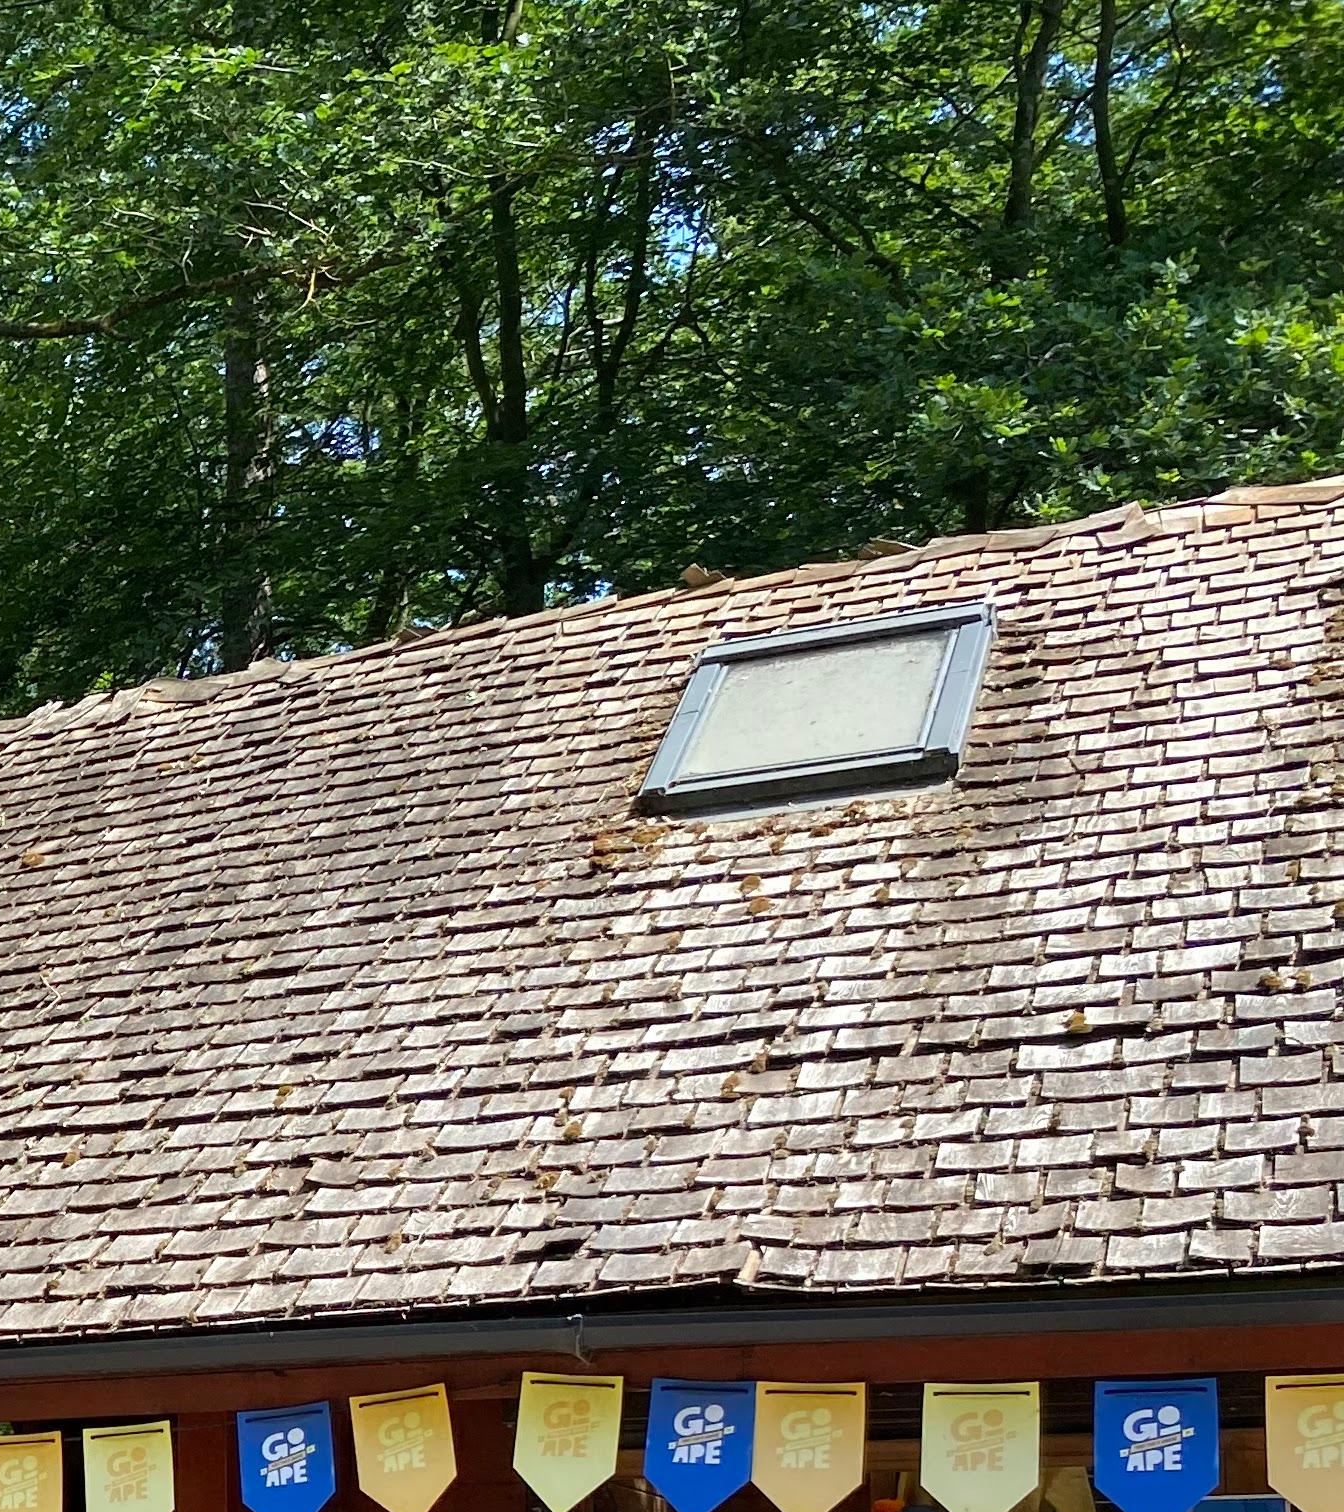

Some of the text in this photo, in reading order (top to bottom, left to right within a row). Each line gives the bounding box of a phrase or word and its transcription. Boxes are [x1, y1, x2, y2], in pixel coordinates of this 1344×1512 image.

[541, 1434, 588, 1458] APE
[672, 1439, 721, 1465] APE
[781, 1443, 831, 1469] APE
[951, 1445, 1004, 1472] APE
[1126, 1444, 1182, 1472] APE
[1303, 1444, 1344, 1469] AP
[383, 1446, 427, 1473] APE
[265, 1462, 308, 1488] APE
[0, 1486, 38, 1510] APE
[108, 1479, 148, 1502] APE
